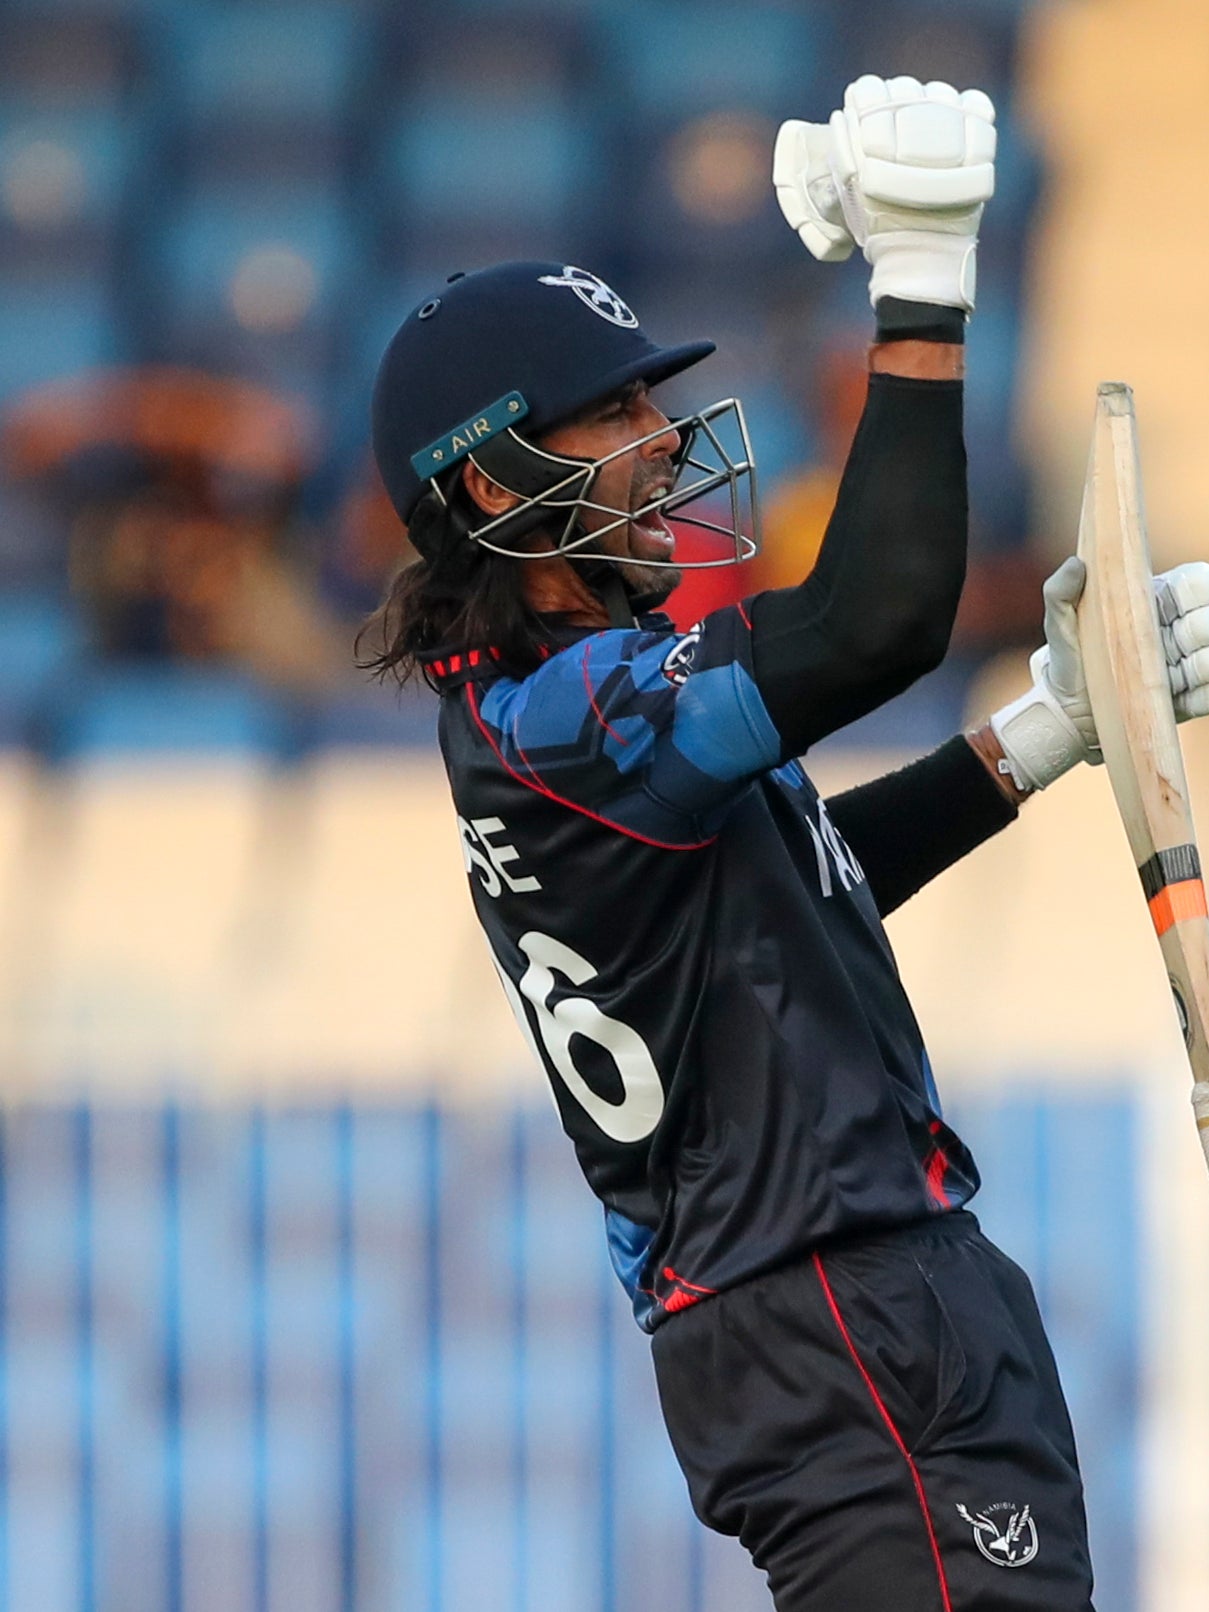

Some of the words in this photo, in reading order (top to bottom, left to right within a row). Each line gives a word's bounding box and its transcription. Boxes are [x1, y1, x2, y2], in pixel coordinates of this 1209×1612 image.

[451, 417, 491, 454] AIR
[457, 815, 543, 898] SE
[490, 930, 665, 1144] 6
